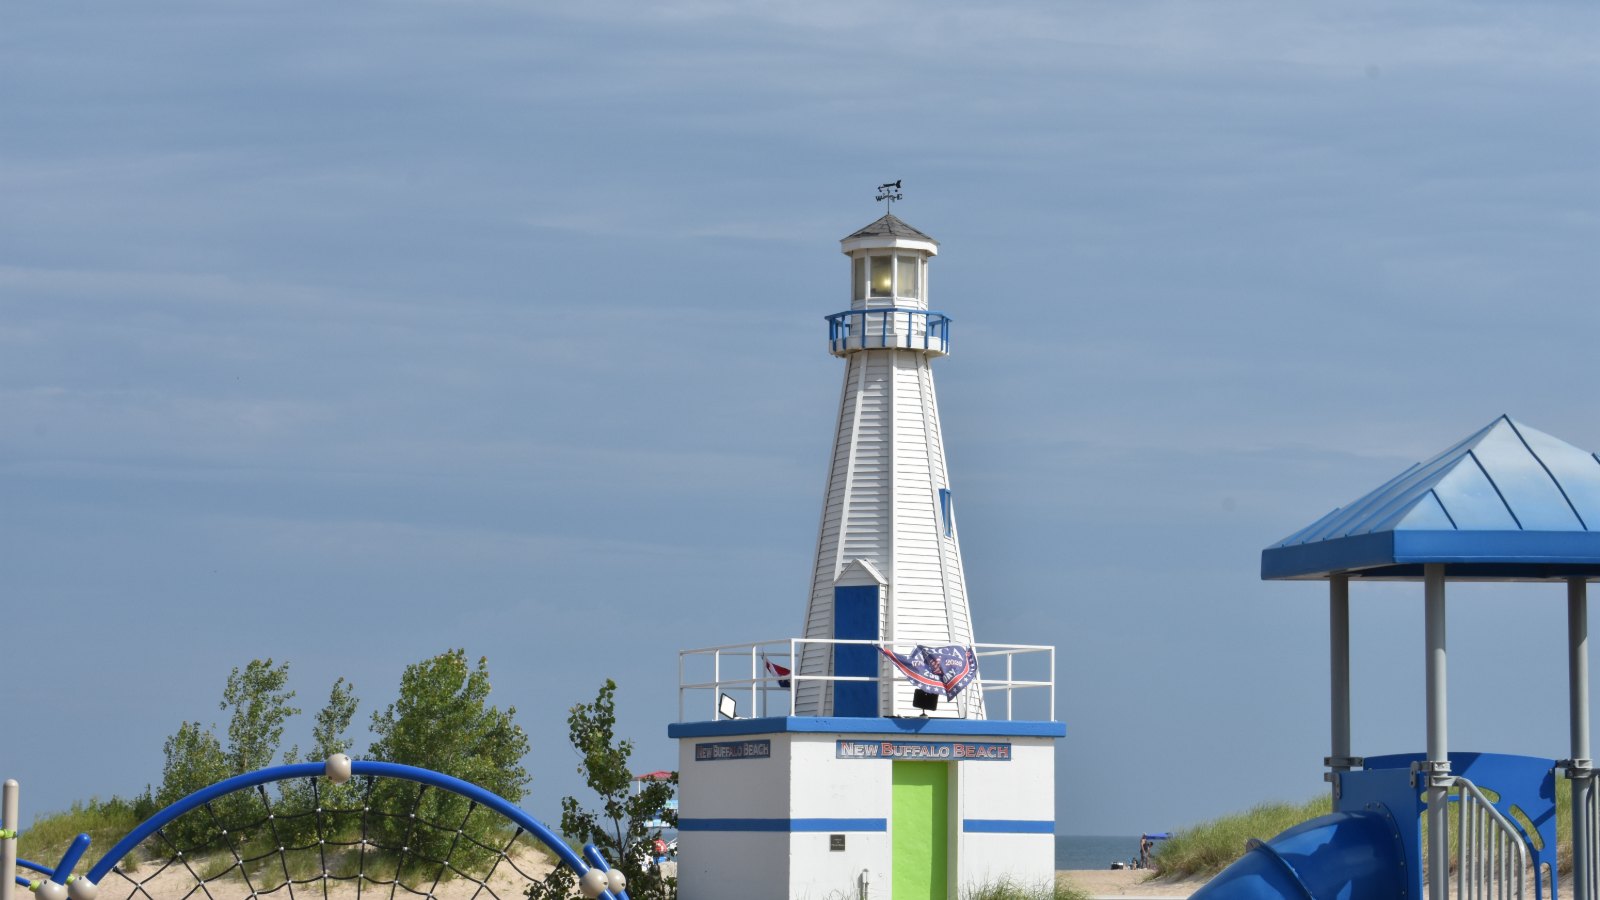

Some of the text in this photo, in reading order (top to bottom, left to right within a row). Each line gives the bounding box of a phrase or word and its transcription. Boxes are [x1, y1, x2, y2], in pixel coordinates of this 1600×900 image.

[697, 743, 769, 758] NEW BUFFALO BEACH
[841, 742, 1009, 758] NEW BUFFALO BEACH
